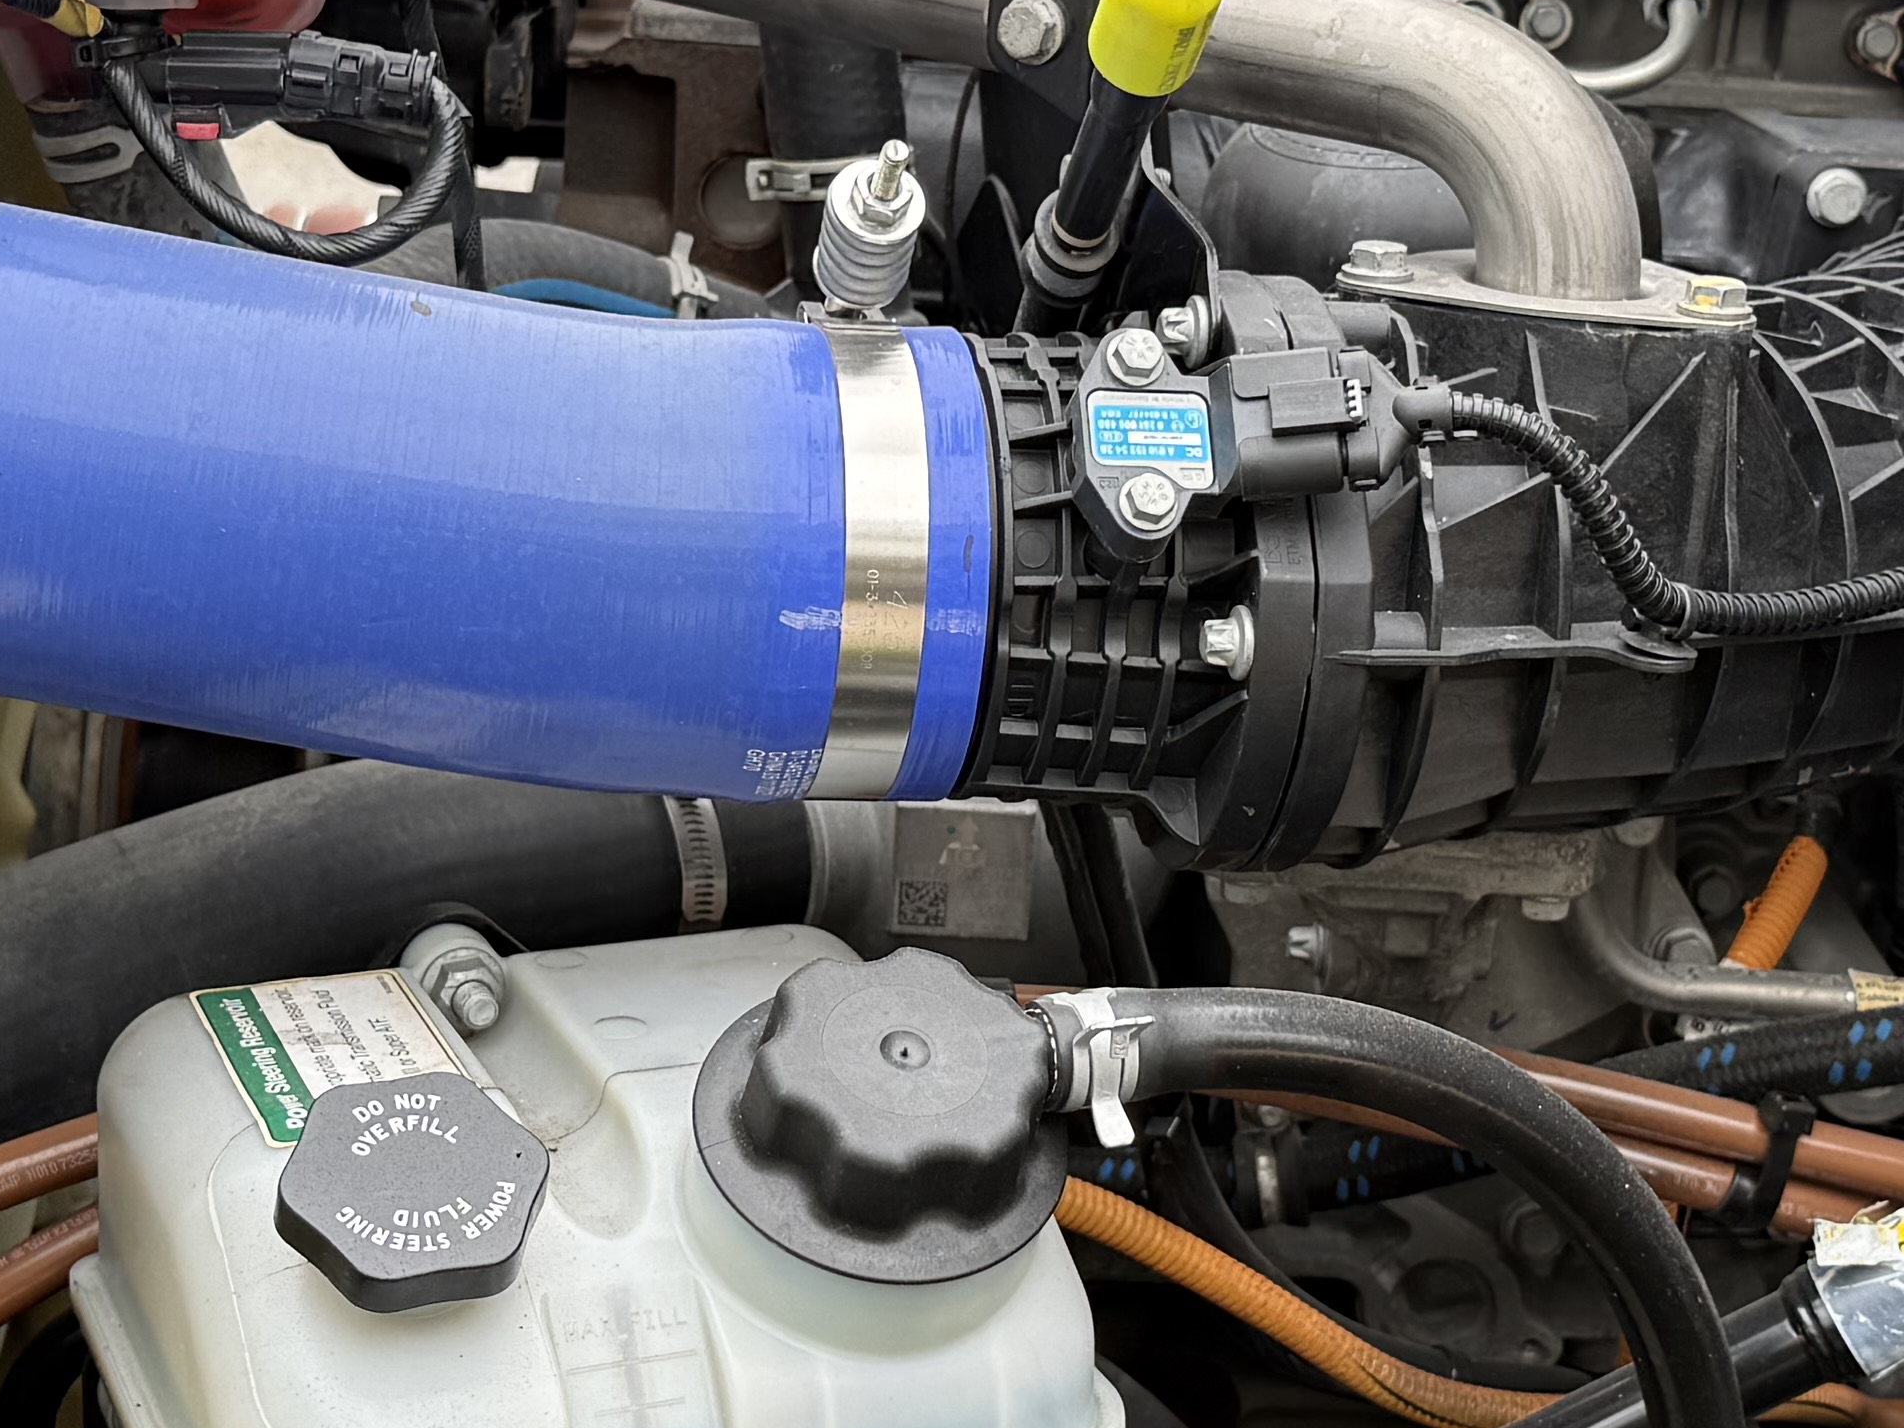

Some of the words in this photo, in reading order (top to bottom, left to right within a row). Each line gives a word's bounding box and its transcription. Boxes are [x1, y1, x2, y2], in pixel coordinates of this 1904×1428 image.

[219, 997, 266, 1048] Reservoir
[250, 1046, 292, 1095] Steering
[276, 1093, 309, 1130] Power
[351, 1100, 385, 1124] DO
[393, 1093, 442, 1111] NOT
[351, 1114, 460, 1157] OVERFILL
[335, 1206, 451, 1252] STEERING
[392, 1196, 473, 1228] FLUID
[460, 1180, 516, 1240] POWER
